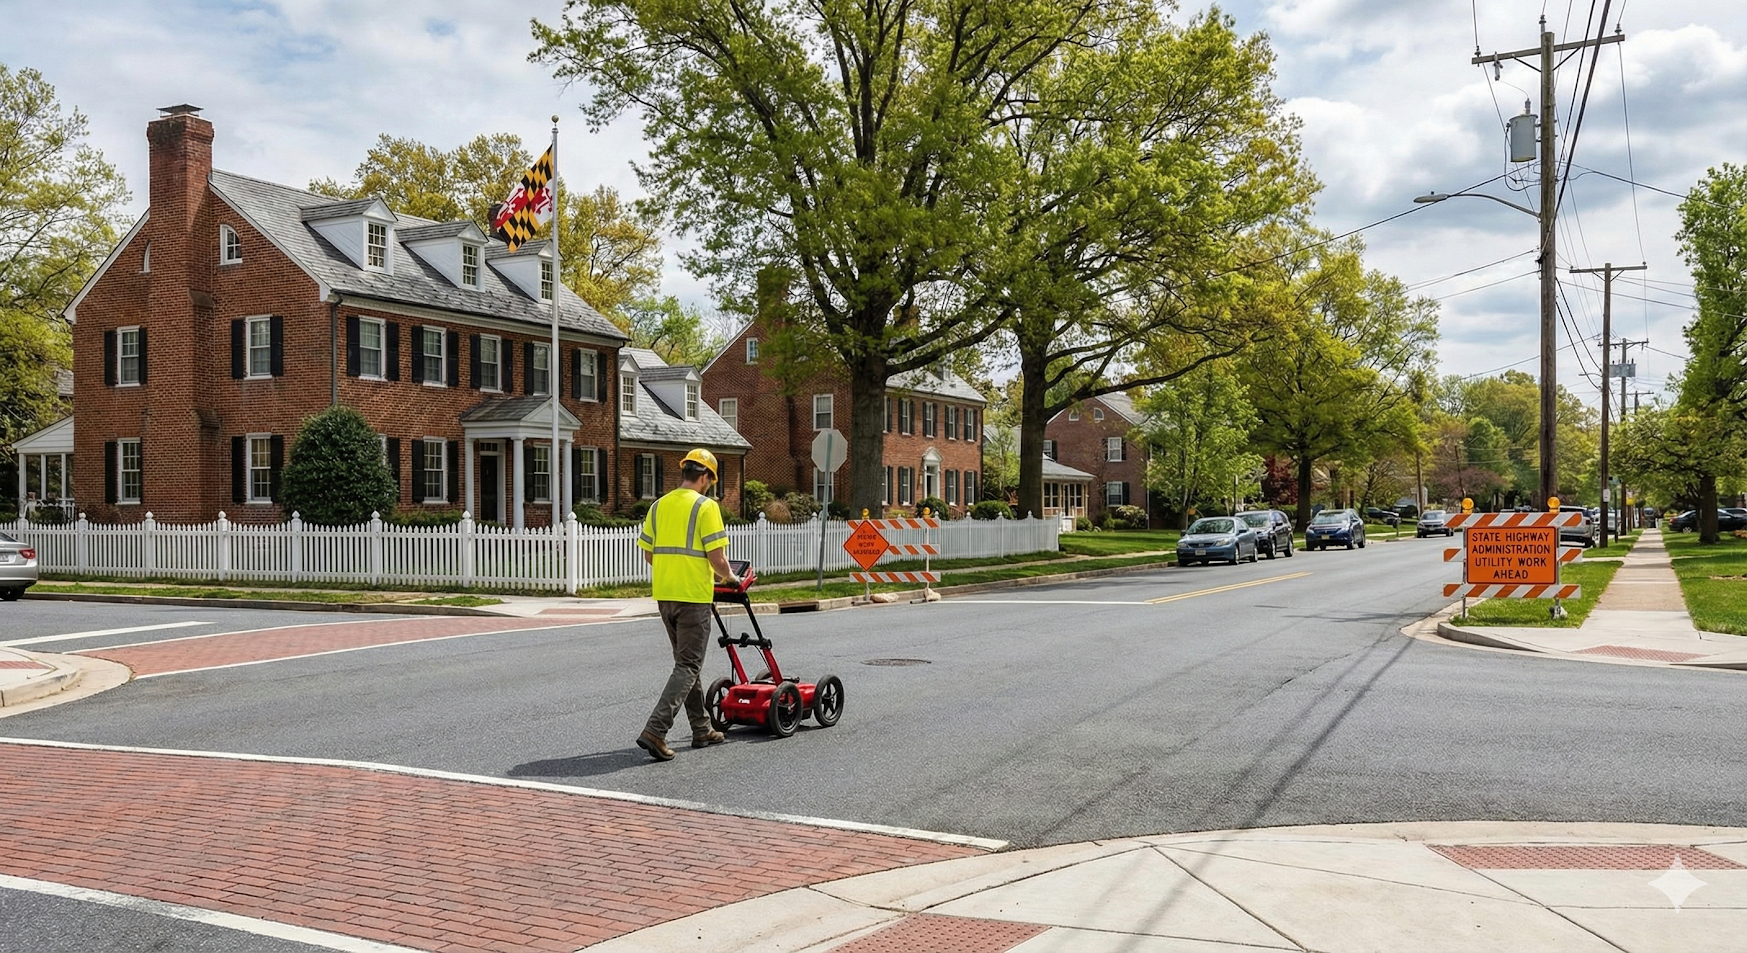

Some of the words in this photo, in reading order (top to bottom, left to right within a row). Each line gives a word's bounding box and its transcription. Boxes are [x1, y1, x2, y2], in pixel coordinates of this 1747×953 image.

[1472, 532, 1501, 542] STATE
[1505, 532, 1550, 542] HIGHWAY
[1472, 544, 1551, 554] ADMINISTRATION
[1475, 557, 1512, 567] UTILITY
[1518, 557, 1547, 567] WORK
[1493, 569, 1529, 579] AHEAD
